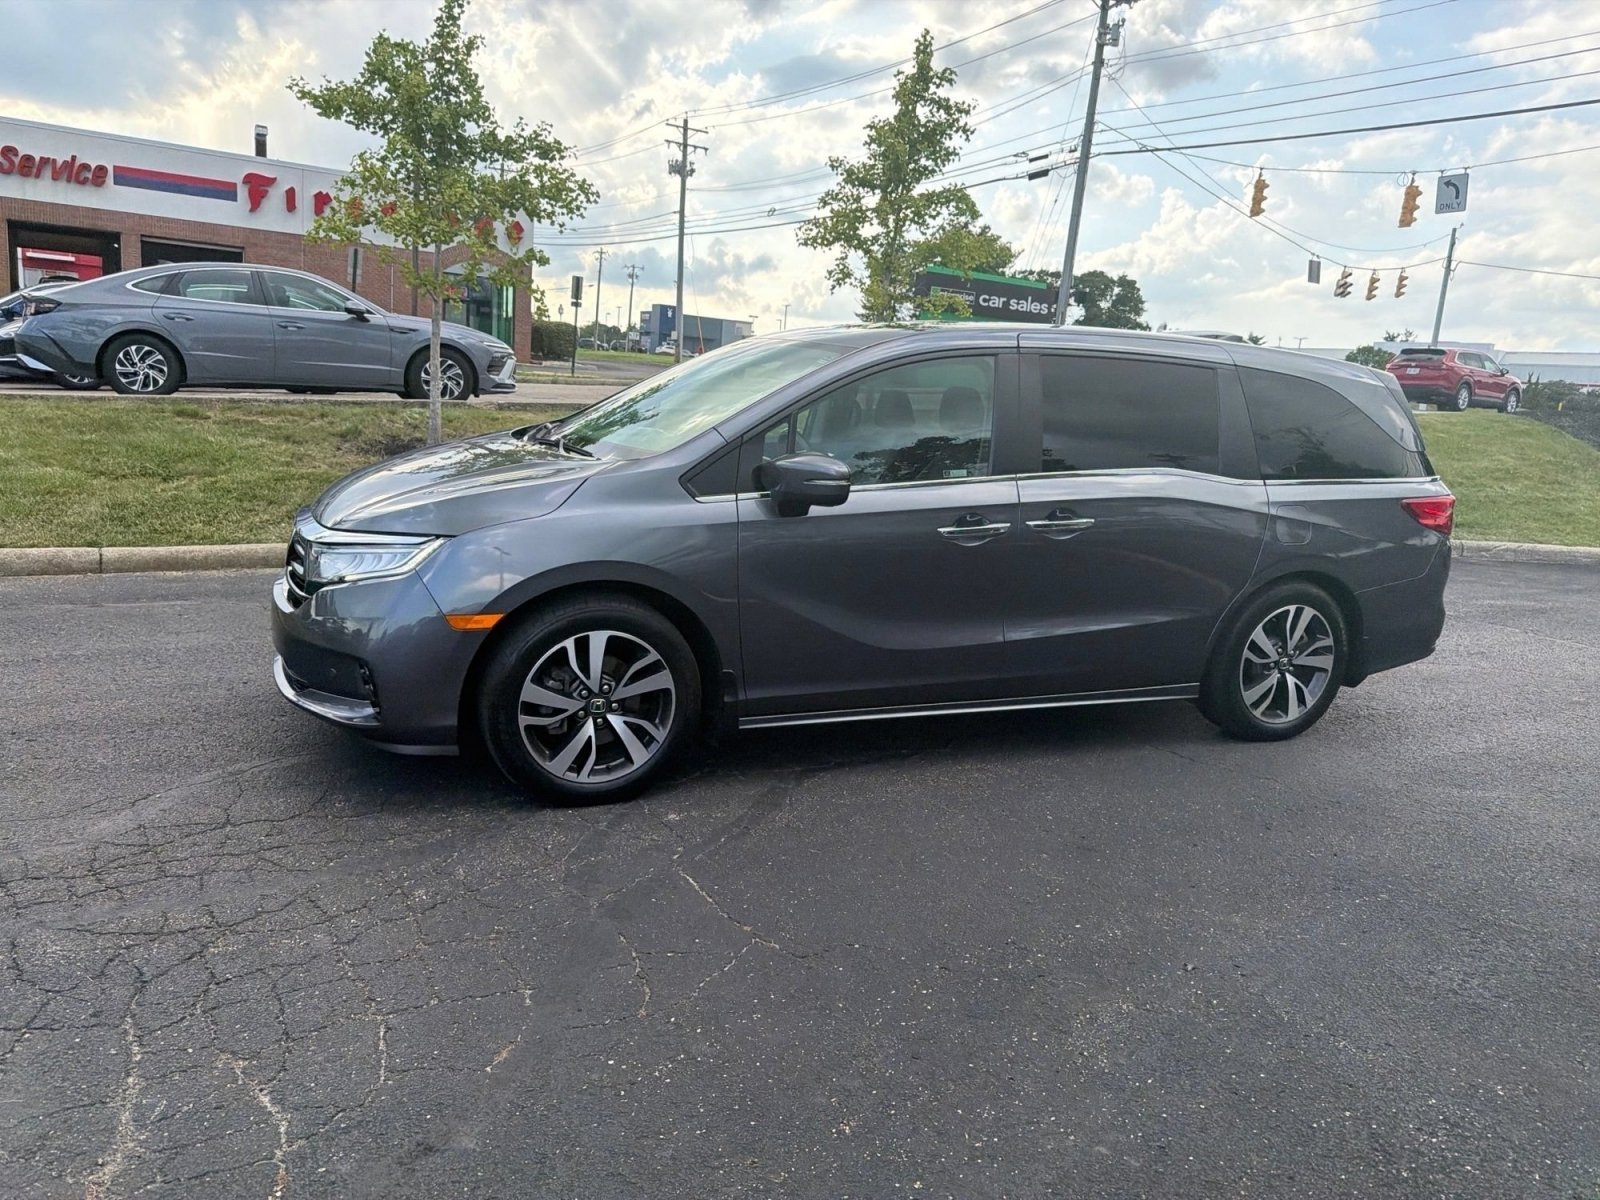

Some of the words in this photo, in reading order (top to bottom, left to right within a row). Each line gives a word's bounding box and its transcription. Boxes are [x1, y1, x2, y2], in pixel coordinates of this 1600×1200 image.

[0, 145, 109, 187] Service
[1440, 201, 1462, 211] ONLY
[979, 294, 1007, 308] car
[1009, 296, 1049, 315] sales
